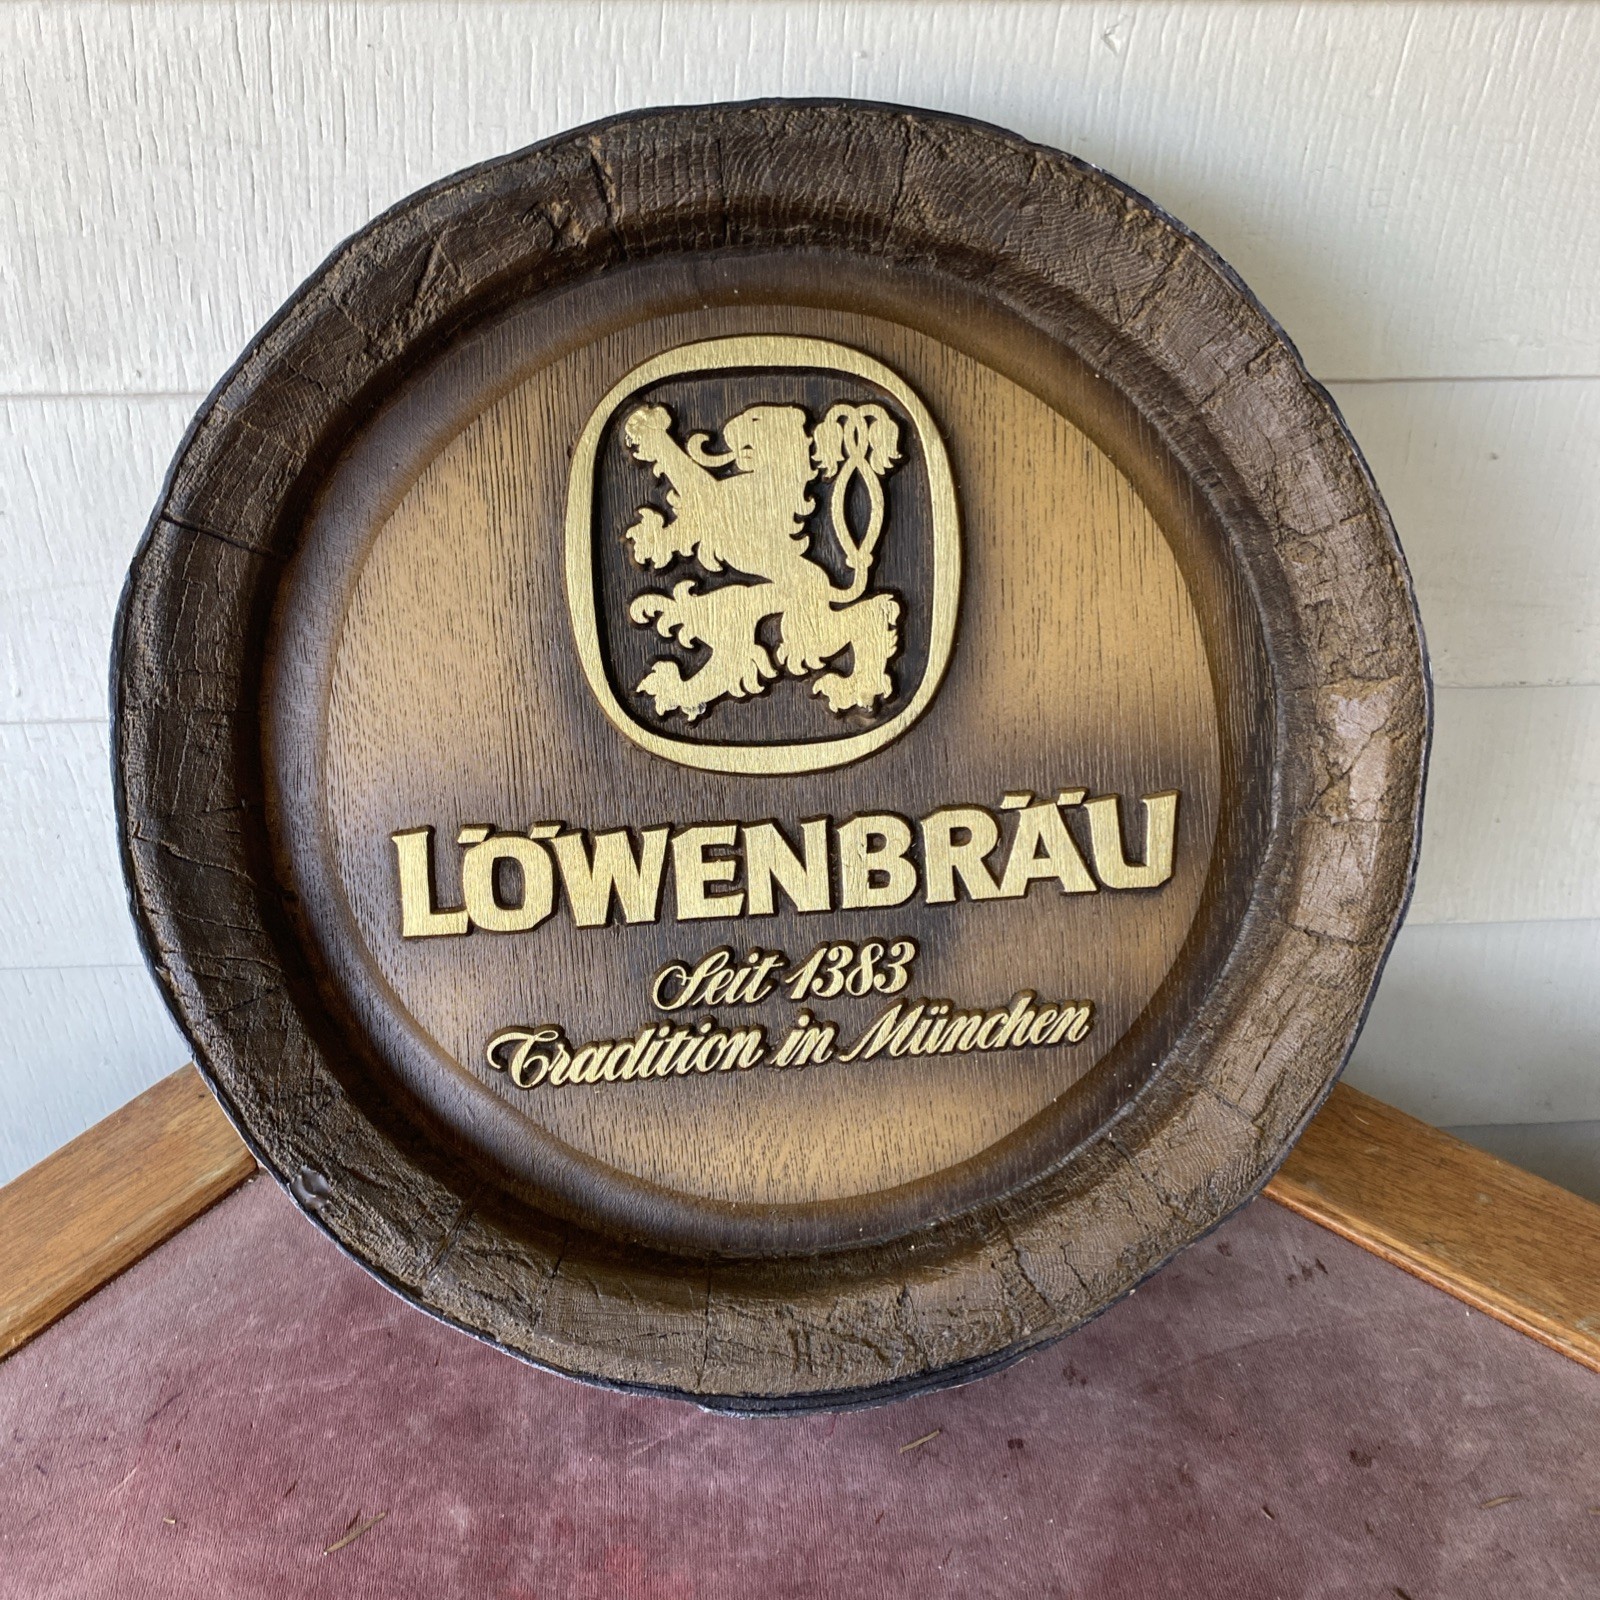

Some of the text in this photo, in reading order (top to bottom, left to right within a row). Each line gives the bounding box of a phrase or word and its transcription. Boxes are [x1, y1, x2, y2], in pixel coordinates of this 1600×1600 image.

[392, 792, 1178, 938] LÖWENBRÄU
[651, 940, 916, 1010] Seit 1383
[486, 996, 1090, 1089] Tradition in München
